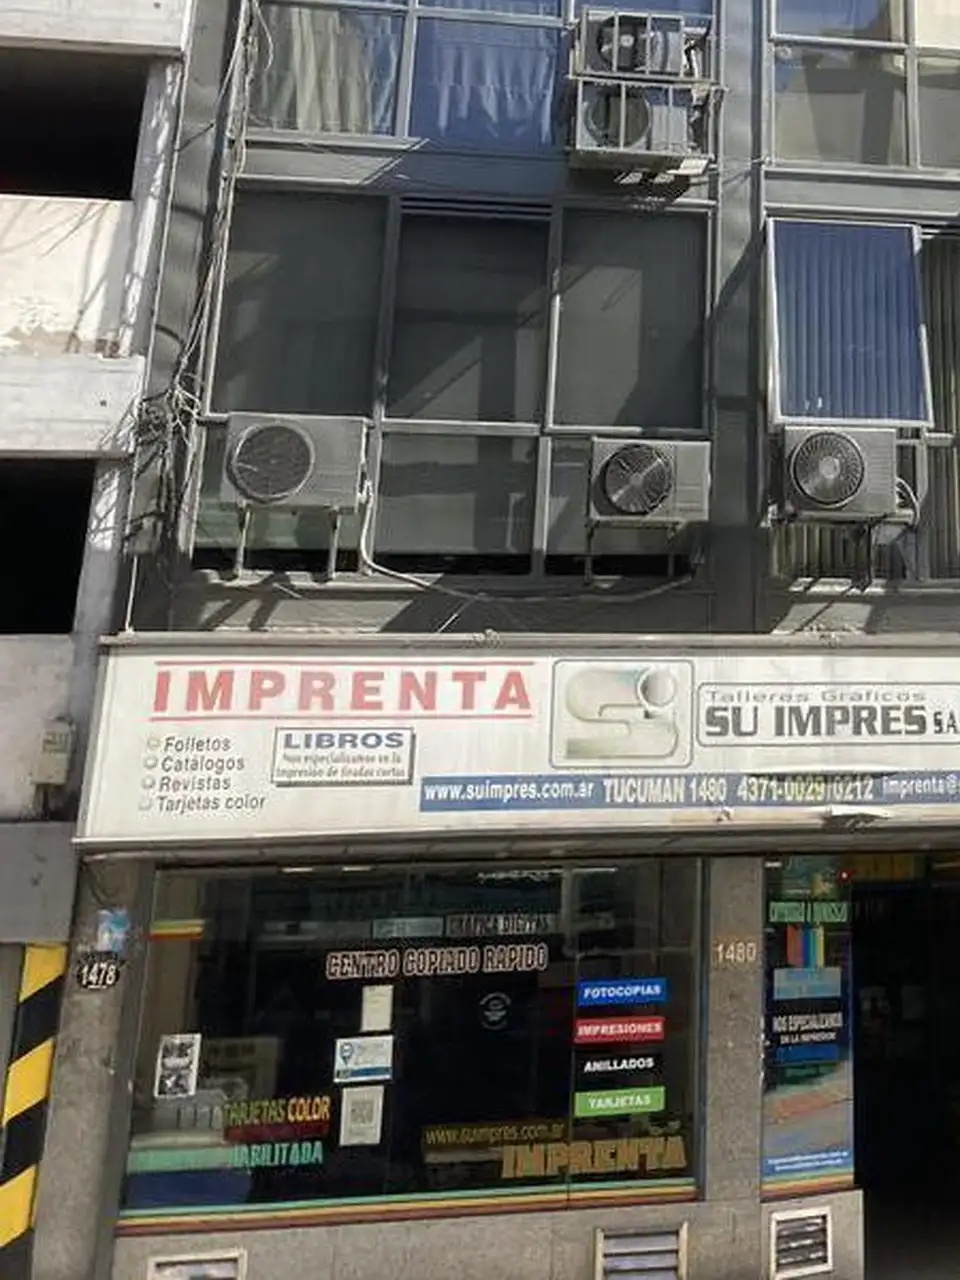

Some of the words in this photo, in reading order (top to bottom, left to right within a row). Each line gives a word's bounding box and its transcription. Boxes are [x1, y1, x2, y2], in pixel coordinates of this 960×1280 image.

[153, 669, 533, 712] IMPRENTA
[707, 689, 810, 704] Talleres
[705, 705, 758, 738] SU
[775, 704, 928, 738] IMPRES
[163, 735, 231, 753] Folletos
[283, 732, 404, 750] LIBROS
[158, 775, 231, 793] Revistas
[424, 779, 595, 803] www.suimpres.com.ar
[603, 778, 685, 804] TUCUMAN
[690, 777, 728, 802] 1480
[157, 795, 221, 817] Tarjetas
[226, 794, 267, 812] color
[327, 951, 400, 980] CENTRO
[483, 943, 548, 972] RAPIDO
[716, 942, 757, 963] 1480
[82, 962, 116, 985] 1478
[584, 984, 661, 999] FOTOCOPIAS
[577, 1022, 663, 1038] IMPRESIONES
[584, 1057, 654, 1073] ANILLADOS
[287, 1094, 331, 1121] COLOR
[588, 1095, 651, 1110] TARJETAS
[502, 1136, 687, 1179] IMPRENTA
